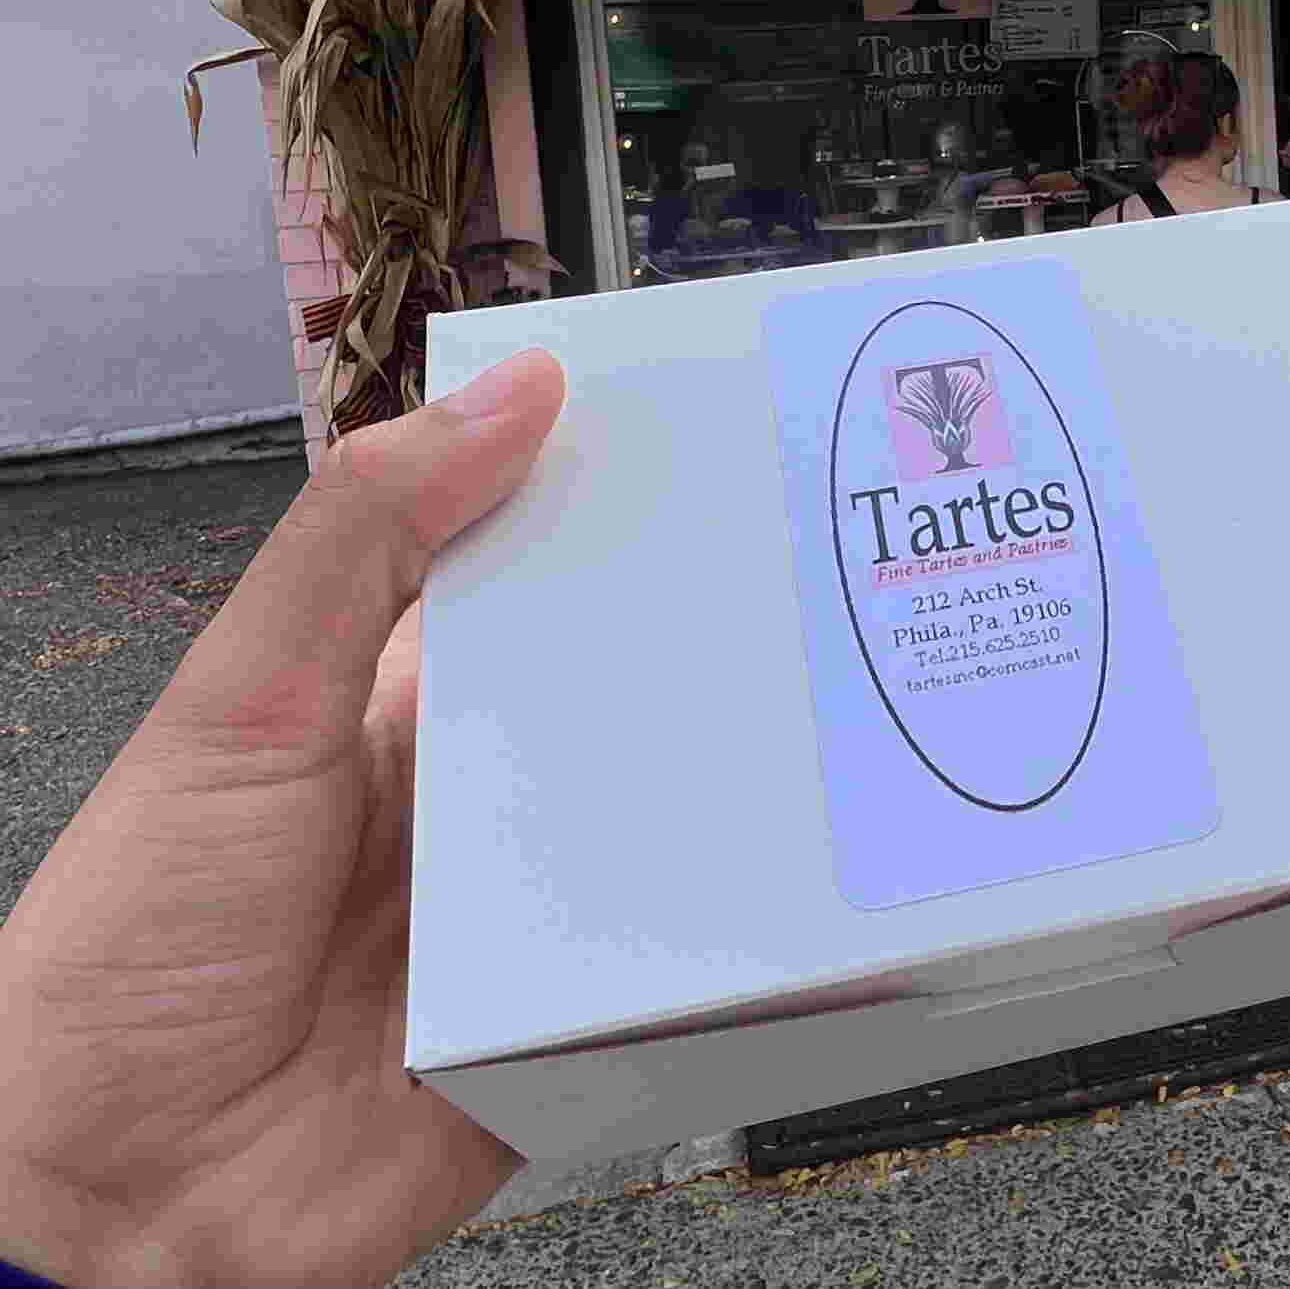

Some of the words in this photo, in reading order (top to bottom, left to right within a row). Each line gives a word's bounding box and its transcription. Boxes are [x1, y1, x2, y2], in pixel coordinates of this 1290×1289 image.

[857, 35, 1002, 78] Tartes
[850, 478, 1074, 565] Tartes
[878, 565, 913, 583] Fine
[919, 555, 968, 574] Tartes
[973, 547, 1001, 562] and
[1007, 536, 1070, 558] Pastries
[912, 592, 952, 615] 212
[960, 581, 1011, 607] Arch
[1015, 576, 1043, 596] St.
[968, 614, 1005, 634] Pa.
[1010, 598, 1072, 625] 19106
